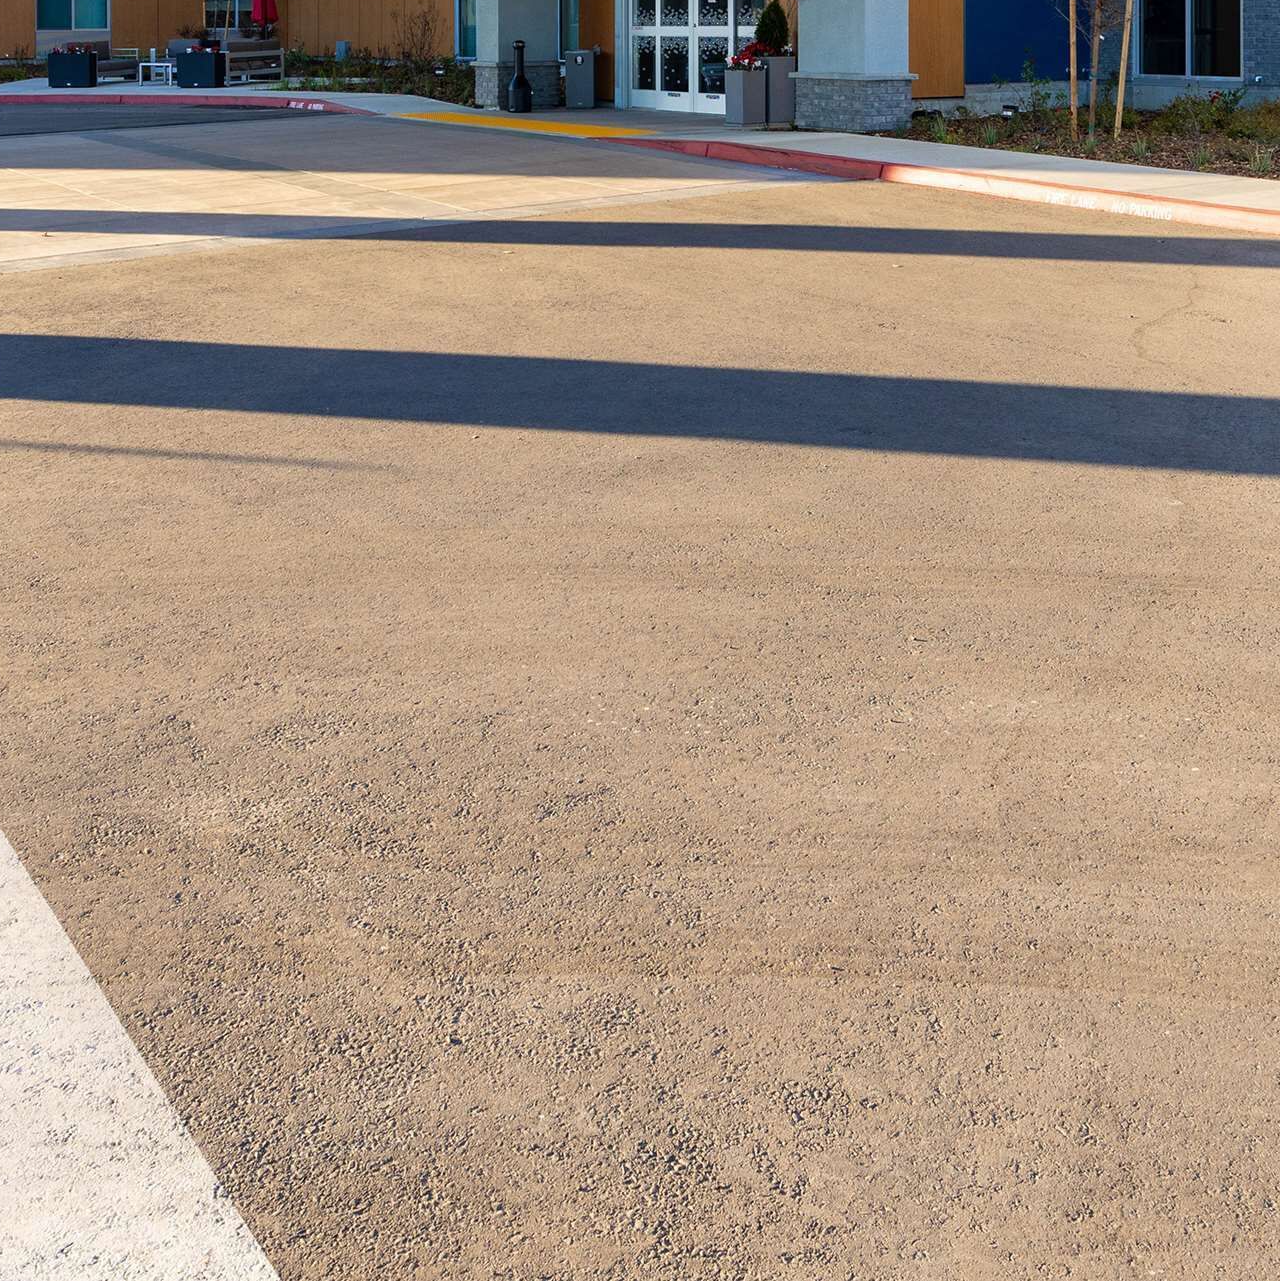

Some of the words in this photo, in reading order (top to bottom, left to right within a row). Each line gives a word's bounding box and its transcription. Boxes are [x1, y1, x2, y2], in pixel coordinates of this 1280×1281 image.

[1071, 194, 1098, 209] LANE
[1111, 199, 1126, 214] NO
[1128, 201, 1173, 220] PARKING
